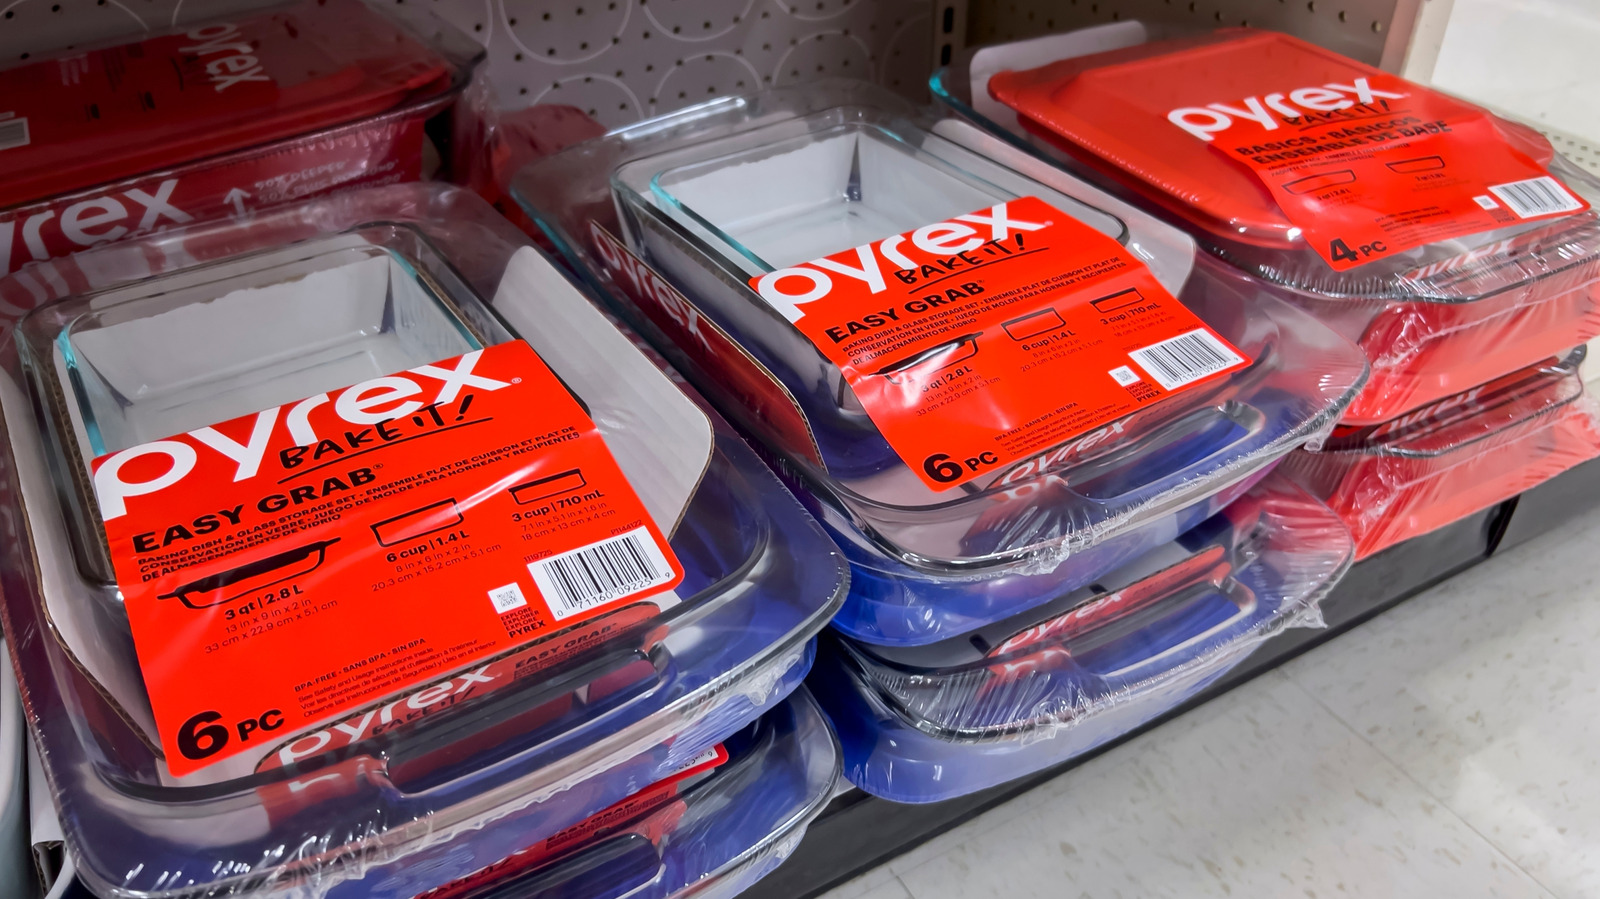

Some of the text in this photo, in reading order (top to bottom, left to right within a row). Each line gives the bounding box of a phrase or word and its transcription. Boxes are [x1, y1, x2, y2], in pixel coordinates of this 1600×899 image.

[178, 23, 271, 92] pyrex
[1167, 78, 1404, 141] pyrex
[1236, 134, 1317, 157] BASICS
[1251, 138, 1368, 164] ENSEMBLE
[1368, 129, 1399, 142] DE
[1399, 120, 1452, 140] BASE
[758, 202, 1046, 324] pyrex
[894, 233, 1025, 284] BAKE IT!
[1329, 238, 1387, 264] 4 PC
[842, 335, 874, 352] BAKING
[873, 328, 894, 339] DISH
[902, 317, 928, 328] GLASS
[928, 306, 964, 320] STORAGE
[964, 301, 978, 309] SET
[983, 288, 1021, 303] ENSEMBLE
[1021, 282, 1040, 291] PLAT
[1051, 268, 1083, 281] CUISSON
[1092, 259, 1109, 268] PLAT
[847, 330, 912, 356] CONSERVATION
[923, 318, 949, 329] VERRE
[954, 309, 980, 320] JUEGO
[991, 297, 1018, 308] MOLDE
[1018, 290, 1039, 300] PARA
[1039, 278, 1075, 293] HORNEAR
[1081, 262, 1126, 279] RECIPIENTES
[1108, 313, 1126, 322] cup
[1128, 306, 1146, 315] 710
[1146, 302, 1160, 310] mL
[824, 307, 899, 343] EASY
[866, 330, 938, 359] ALMACENAMIENTO
[949, 318, 976, 329] VIDRIO
[1030, 339, 1049, 348] cup
[1052, 331, 1068, 340] 1.4
[930, 379, 942, 388] qt
[945, 368, 964, 380] 2.8
[1136, 390, 1160, 402] PYREX
[279, 394, 474, 469] BAKE IT!
[923, 451, 999, 483] 6 PC
[138, 549, 188, 565] BAKING
[191, 538, 222, 552] DISH
[236, 520, 276, 537] GLASS
[278, 502, 333, 523] STORAGE
[335, 494, 355, 504] SET
[365, 473, 423, 495] ENSEMBLE
[426, 464, 451, 476] PLAT
[454, 459, 468, 467] DE
[471, 443, 519, 461] CUISSON
[520, 438, 532, 446] ET
[534, 431, 558, 441] PLAT
[140, 539, 244, 572] CONSERVATION
[246, 532, 263, 542] EN
[265, 518, 304, 535] VERRE
[314, 503, 352, 519] JUEGO
[355, 497, 370, 506] DE
[372, 484, 413, 500] MOLDE
[415, 474, 446, 486] PARA
[447, 455, 501, 476] HORNEAR
[512, 431, 579, 455] RECIPIENTES
[512, 489, 604, 521] 3 cup 710 mL
[132, 504, 243, 553] EASY
[386, 530, 469, 562] 6 cup 1.4 L
[142, 514, 341, 582] DE ALMACENAMIENTO DE VIDRIO
[225, 584, 303, 620] 3 qt 2.8 L
[578, 590, 613, 609] 71160
[617, 578, 652, 595] 09225
[664, 571, 671, 579] 9
[225, 624, 237, 633] 13
[239, 620, 250, 628] in
[500, 606, 531, 623] EXPLORE
[503, 610, 539, 628] EXPLORER
[505, 616, 536, 632] EXPLORE
[508, 620, 545, 638] PYREX
[294, 638, 425, 692] BPA-FREE SANS BPA SIN BPA
[515, 644, 561, 668] EASY
[177, 709, 285, 760] 6 PC
[279, 664, 495, 770] pyrex
